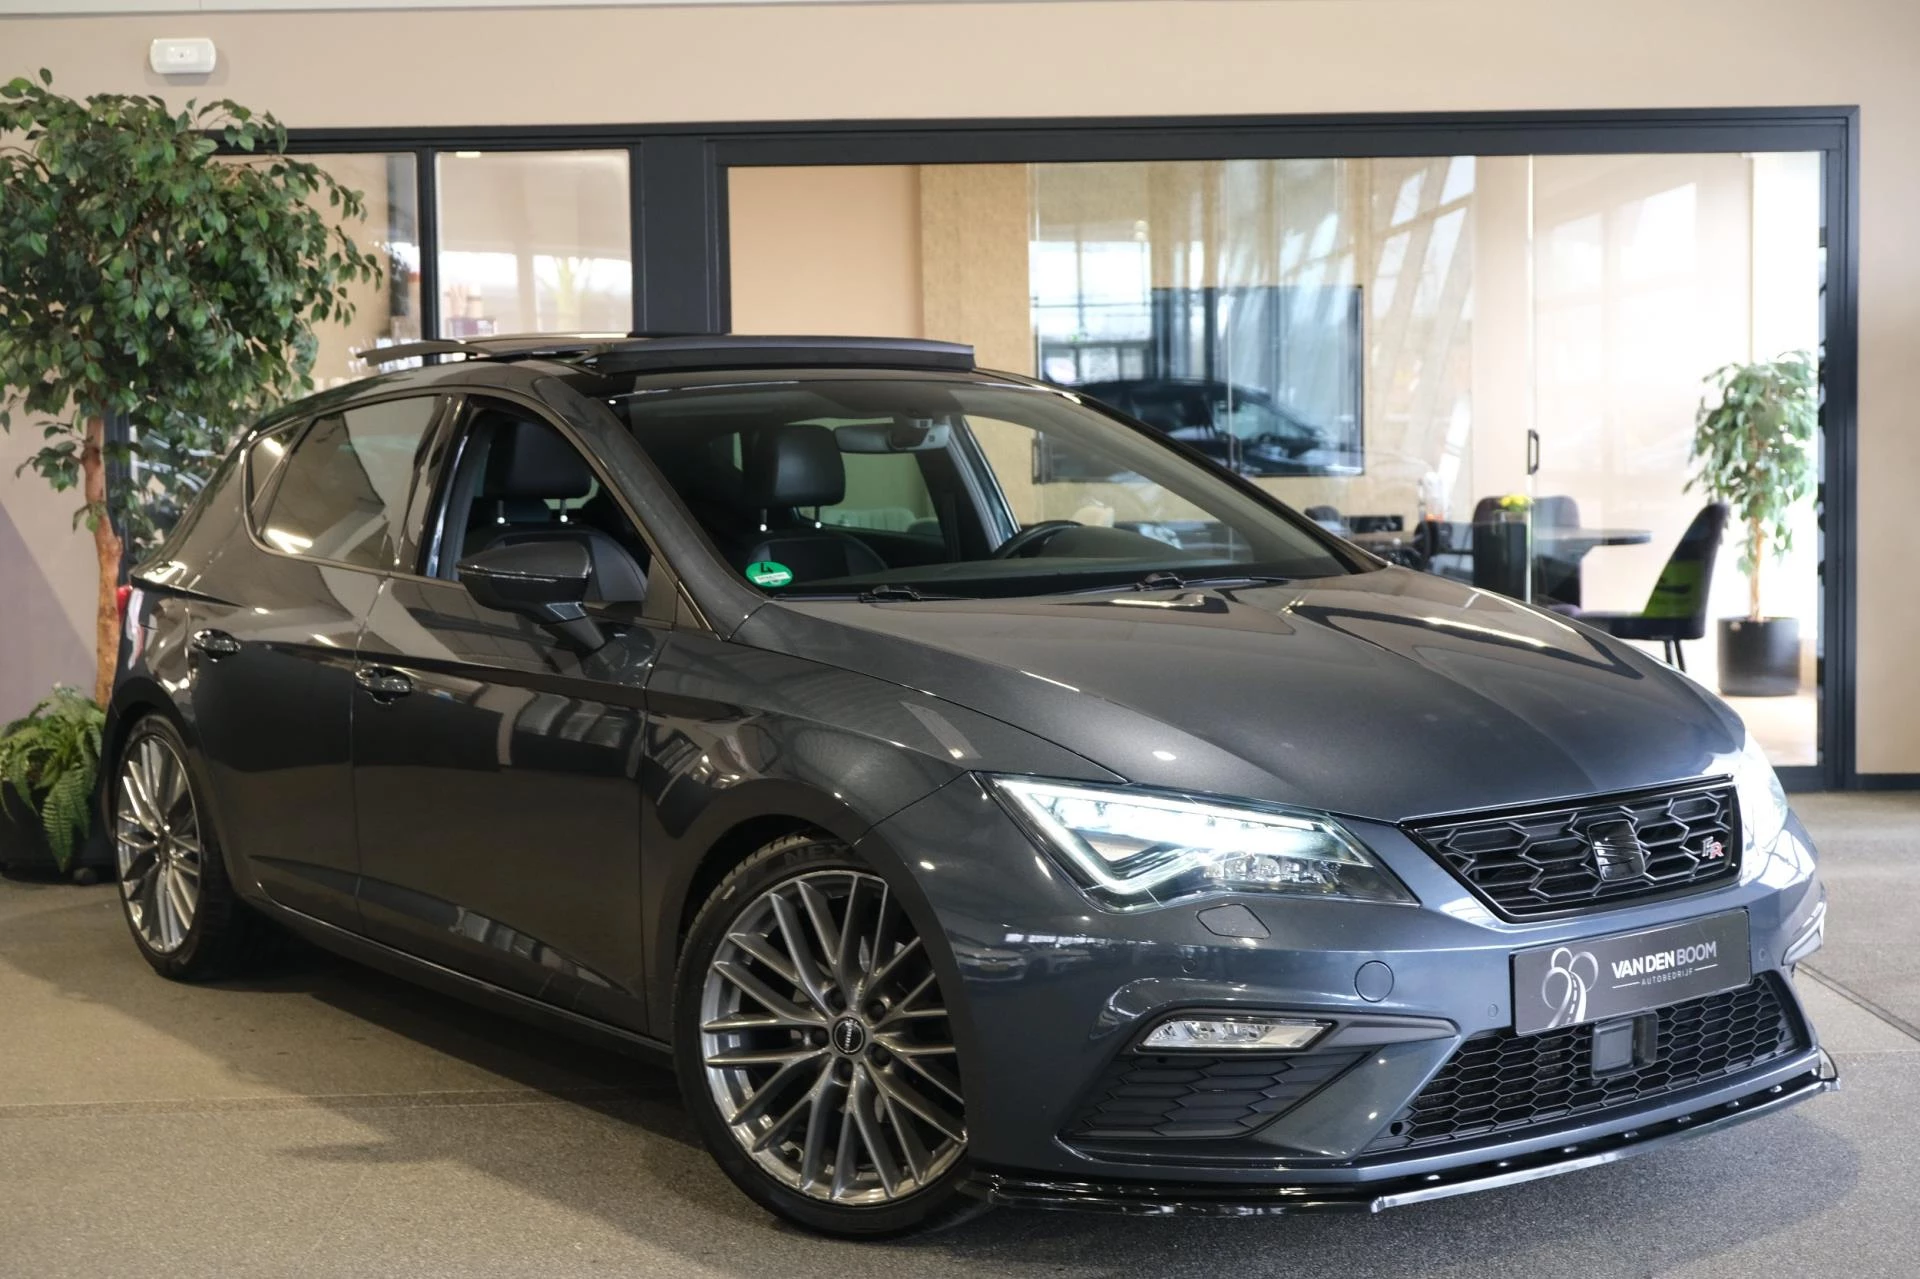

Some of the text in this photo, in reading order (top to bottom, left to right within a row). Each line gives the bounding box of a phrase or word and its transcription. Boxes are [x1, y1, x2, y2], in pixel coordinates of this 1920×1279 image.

[1702, 836, 1724, 859] FR
[1611, 940, 1717, 979] VAN DEN BOOM
[1641, 967, 1693, 986] AUTOBEDRIJF
